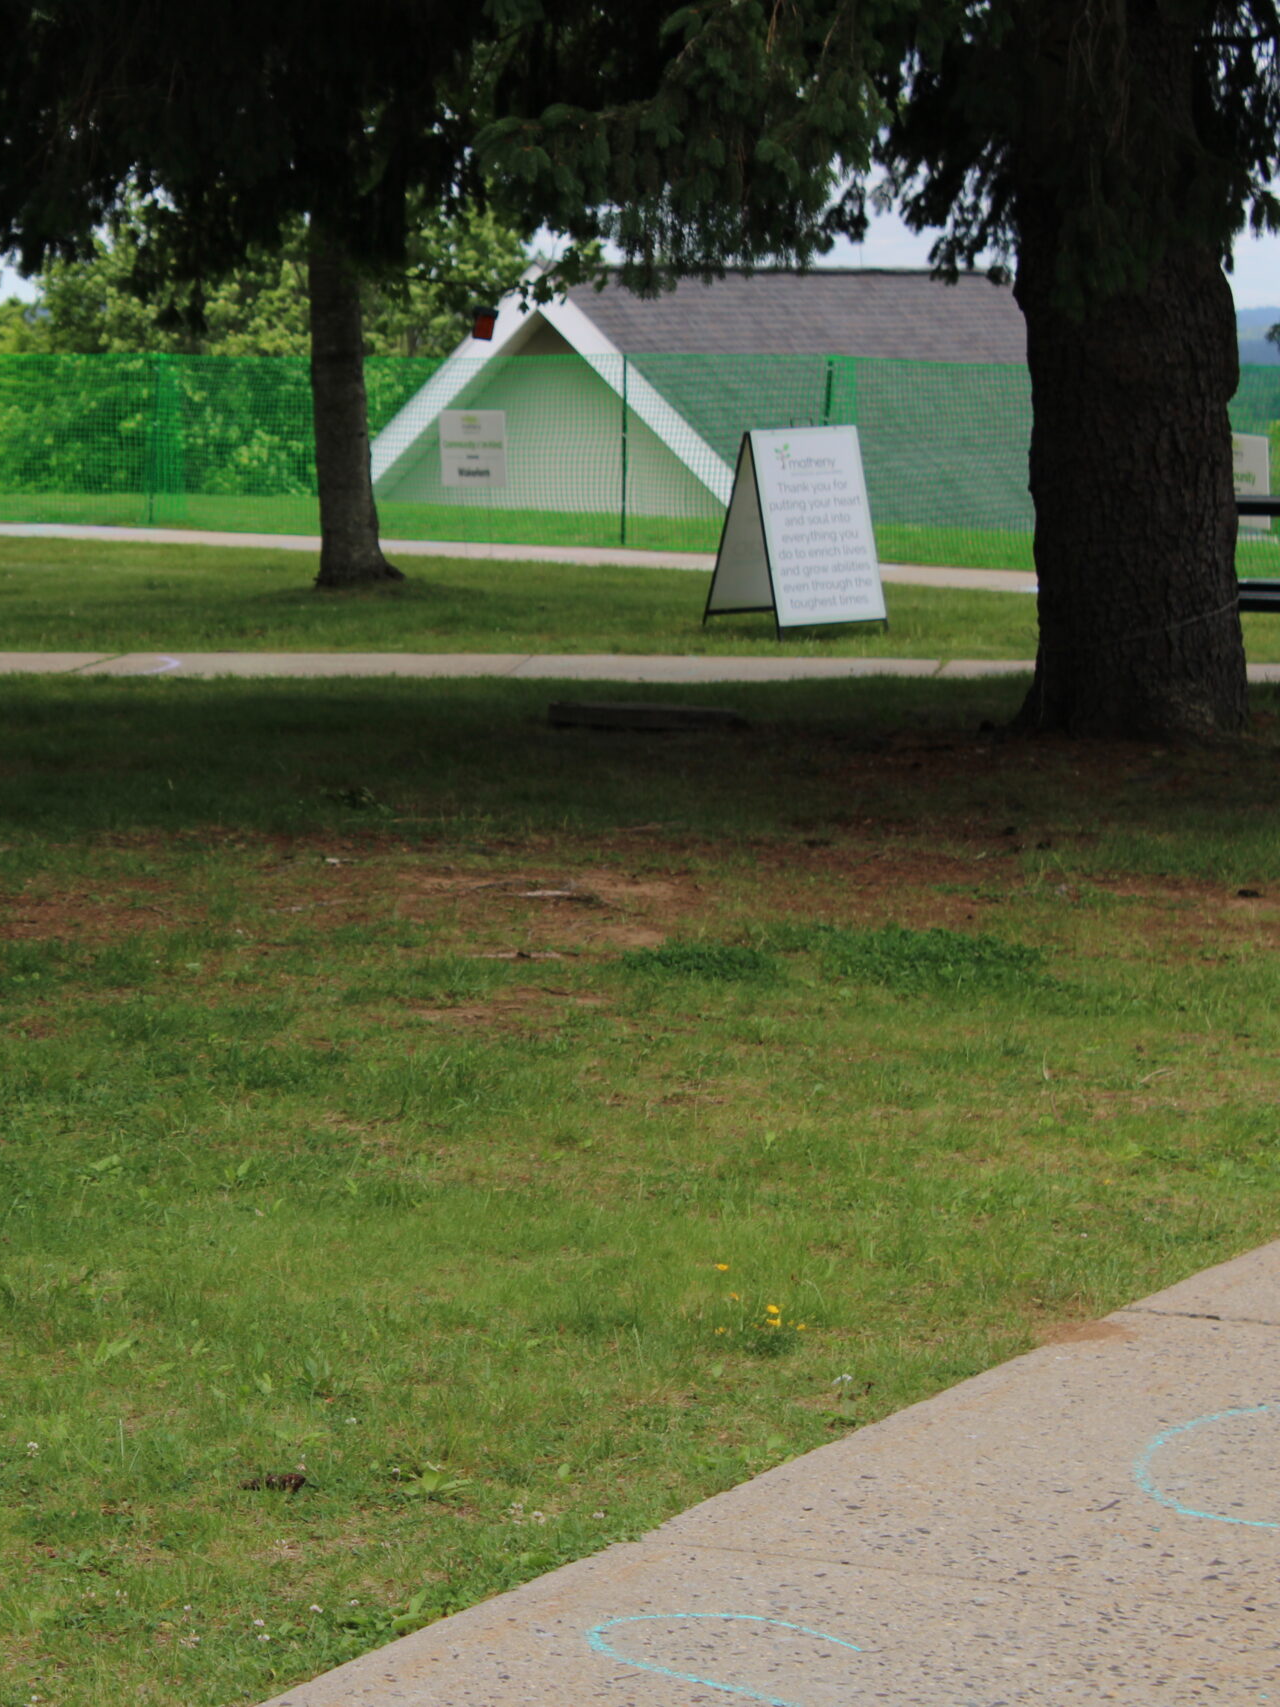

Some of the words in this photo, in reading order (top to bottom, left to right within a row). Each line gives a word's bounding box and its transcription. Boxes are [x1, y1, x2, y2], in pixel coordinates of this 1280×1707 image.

[778, 482, 809, 495] Thank
[811, 482, 831, 495] you
[833, 479, 848, 490] for
[769, 499, 807, 513] putting
[808, 499, 832, 512] your
[833, 495, 861, 507] heart
[785, 515, 805, 527] and
[807, 513, 830, 525] soul
[830, 512, 851, 523] into
[781, 529, 837, 545] everything
[839, 530, 859, 542] you
[779, 548, 793, 560] do
[795, 547, 806, 559] to
[808, 546, 841, 558] enrich
[842, 544, 867, 556] lives
[780, 564, 800, 577] and
[802, 566, 828, 578] grow
[831, 560, 871, 573] abilities
[783, 582, 809, 594] even
[811, 578, 853, 593] through
[854, 576, 872, 588] the
[790, 595, 837, 611] toughest
